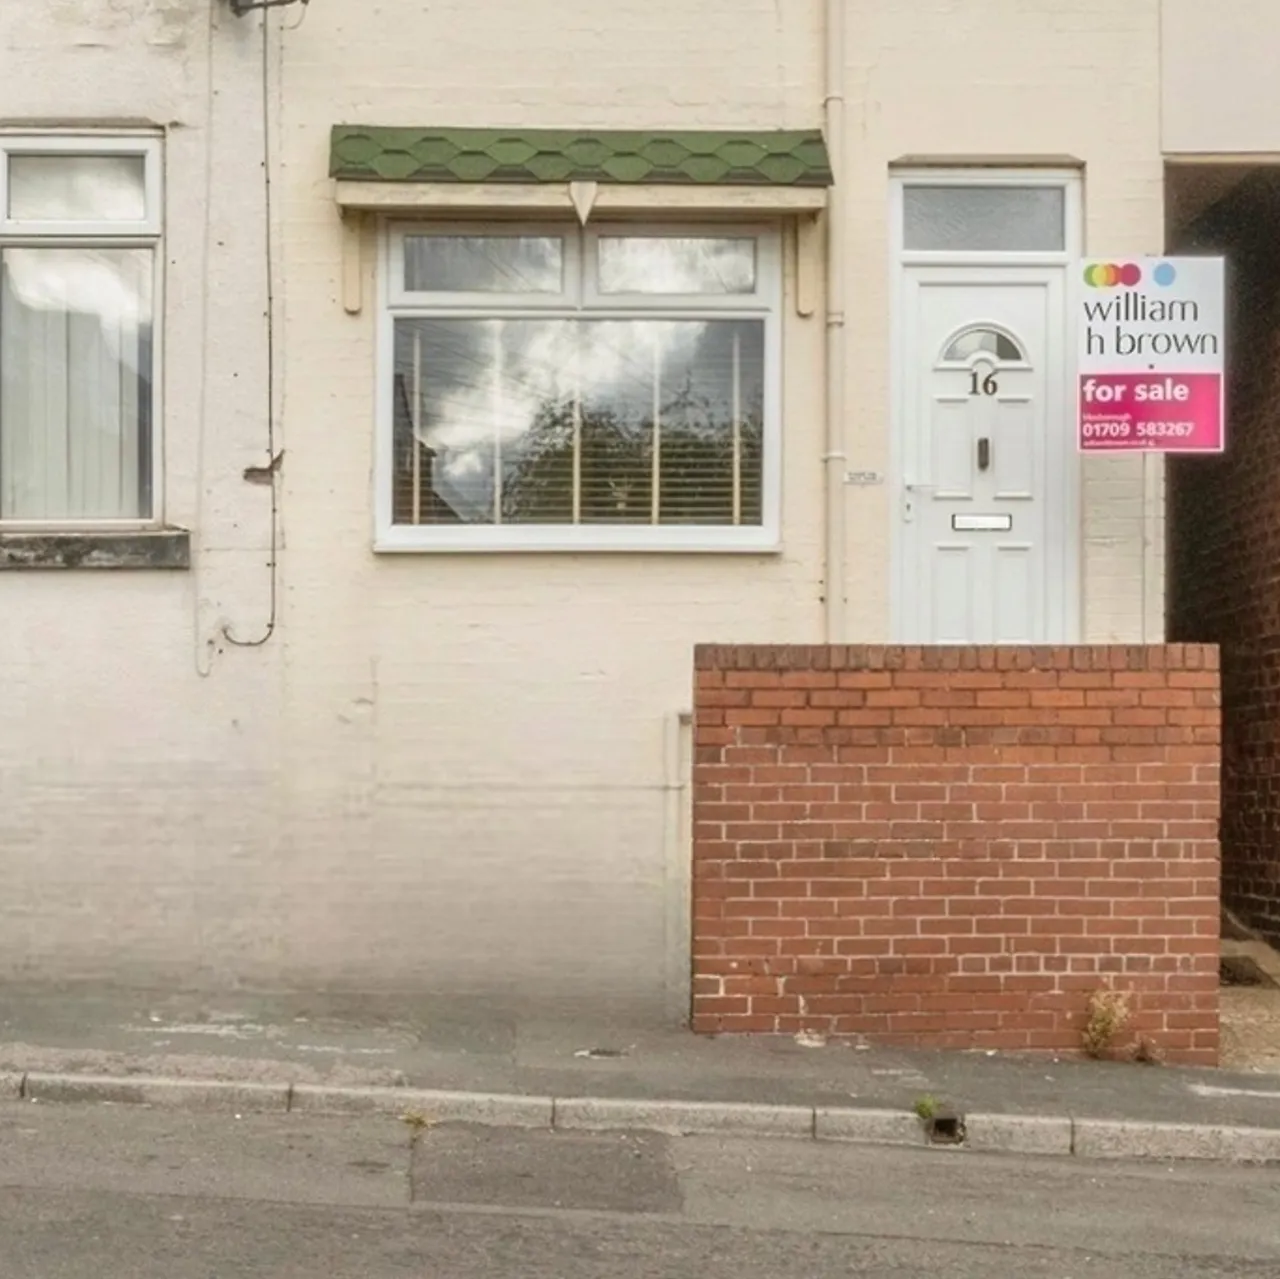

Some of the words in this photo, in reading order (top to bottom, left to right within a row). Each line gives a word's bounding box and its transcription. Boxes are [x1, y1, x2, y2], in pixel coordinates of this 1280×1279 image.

[1083, 291, 1199, 322] william
[1086, 326, 1105, 355] h
[1115, 325, 1219, 356] brown
[968, 371, 999, 396] 16
[1082, 378, 1127, 403] for
[1134, 378, 1190, 402] sale
[1082, 422, 1131, 437] 01709
